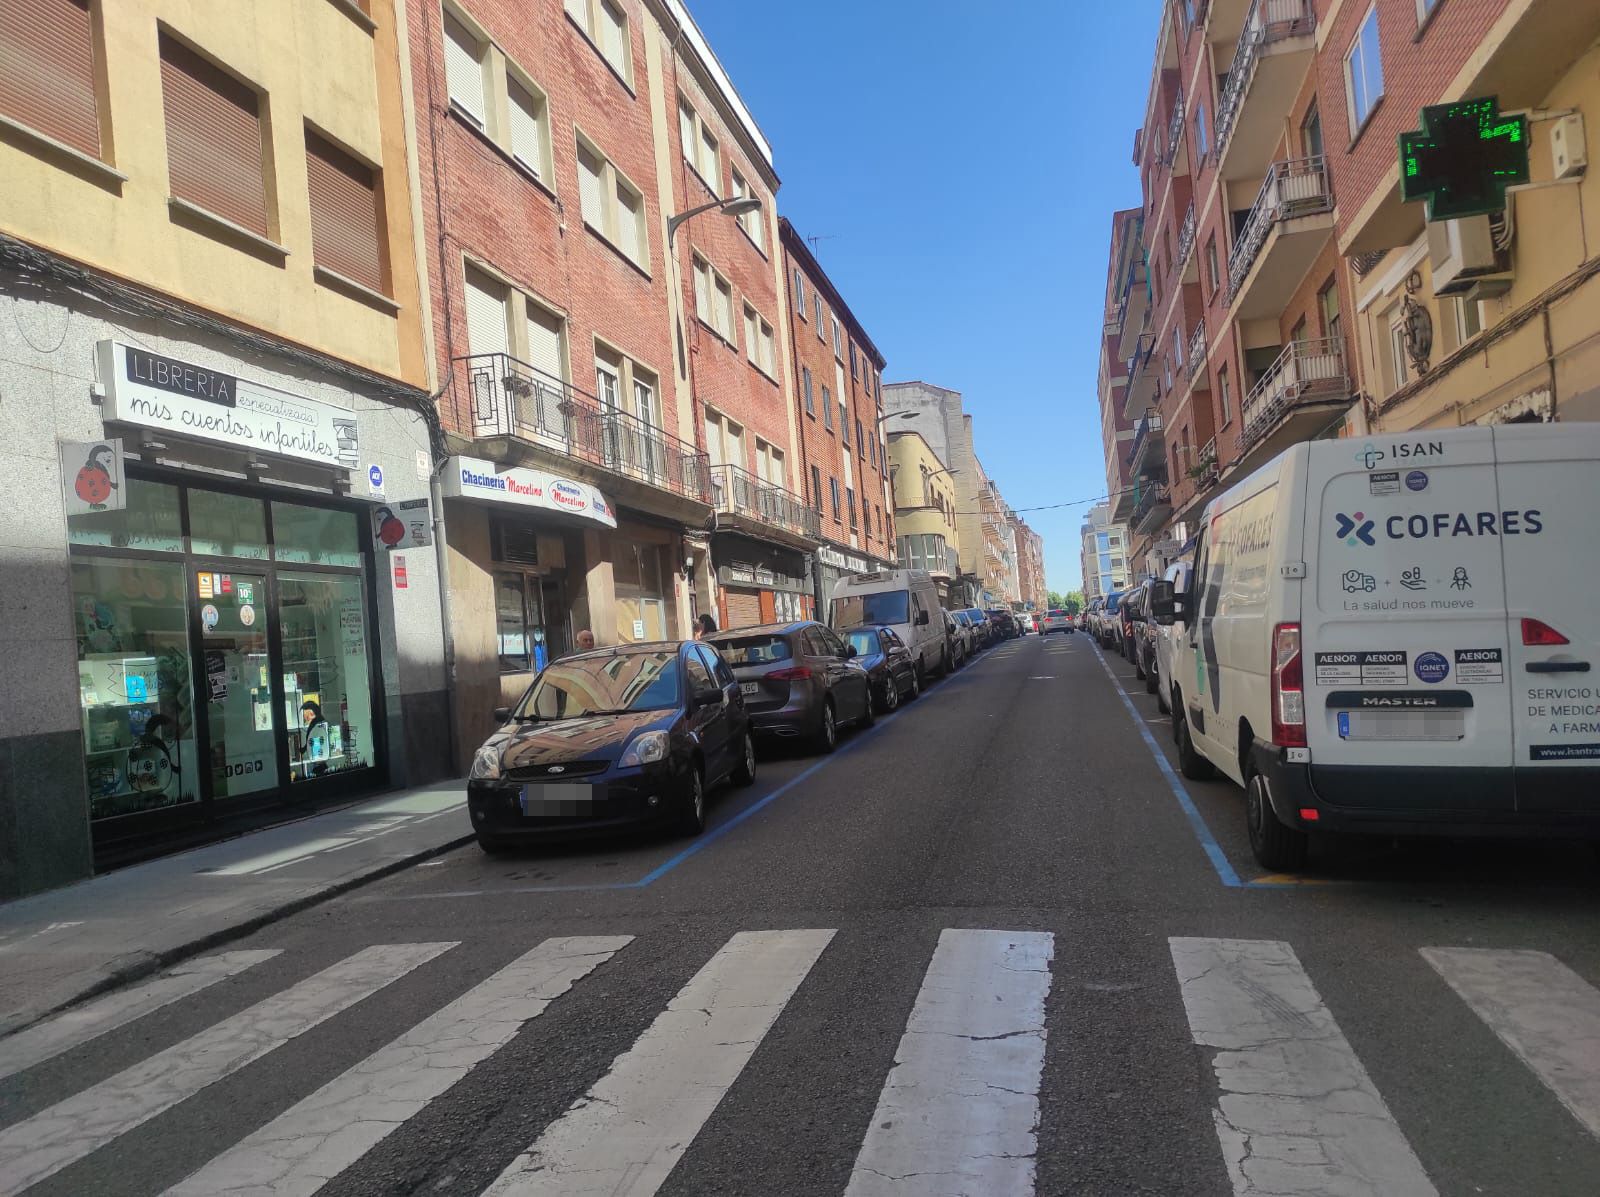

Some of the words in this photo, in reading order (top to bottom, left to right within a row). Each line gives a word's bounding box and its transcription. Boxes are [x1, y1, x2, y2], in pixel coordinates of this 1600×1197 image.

[238, 395, 316, 424] especializada
[130, 396, 173, 421] mis
[181, 408, 253, 439] cuentos
[259, 421, 335, 459] infantiles
[1391, 441, 1444, 458] ISAN
[506, 476, 543, 497] Marcelino
[552, 488, 586, 508] Marcelino
[1386, 509, 1543, 540] COFARES
[1344, 599, 1358, 611] La
[1363, 599, 1398, 610] salud
[1402, 601, 1426, 609] nos
[1430, 600, 1474, 609] mueve
[1320, 655, 1357, 663] AENOR
[1365, 654, 1402, 662] AENOR
[1459, 652, 1498, 660] AENOR
[1528, 688, 1591, 700] SERVICIO
[1363, 697, 1437, 706] MASTER
[1528, 706, 1546, 717] DE
[1549, 723, 1559, 733] A
